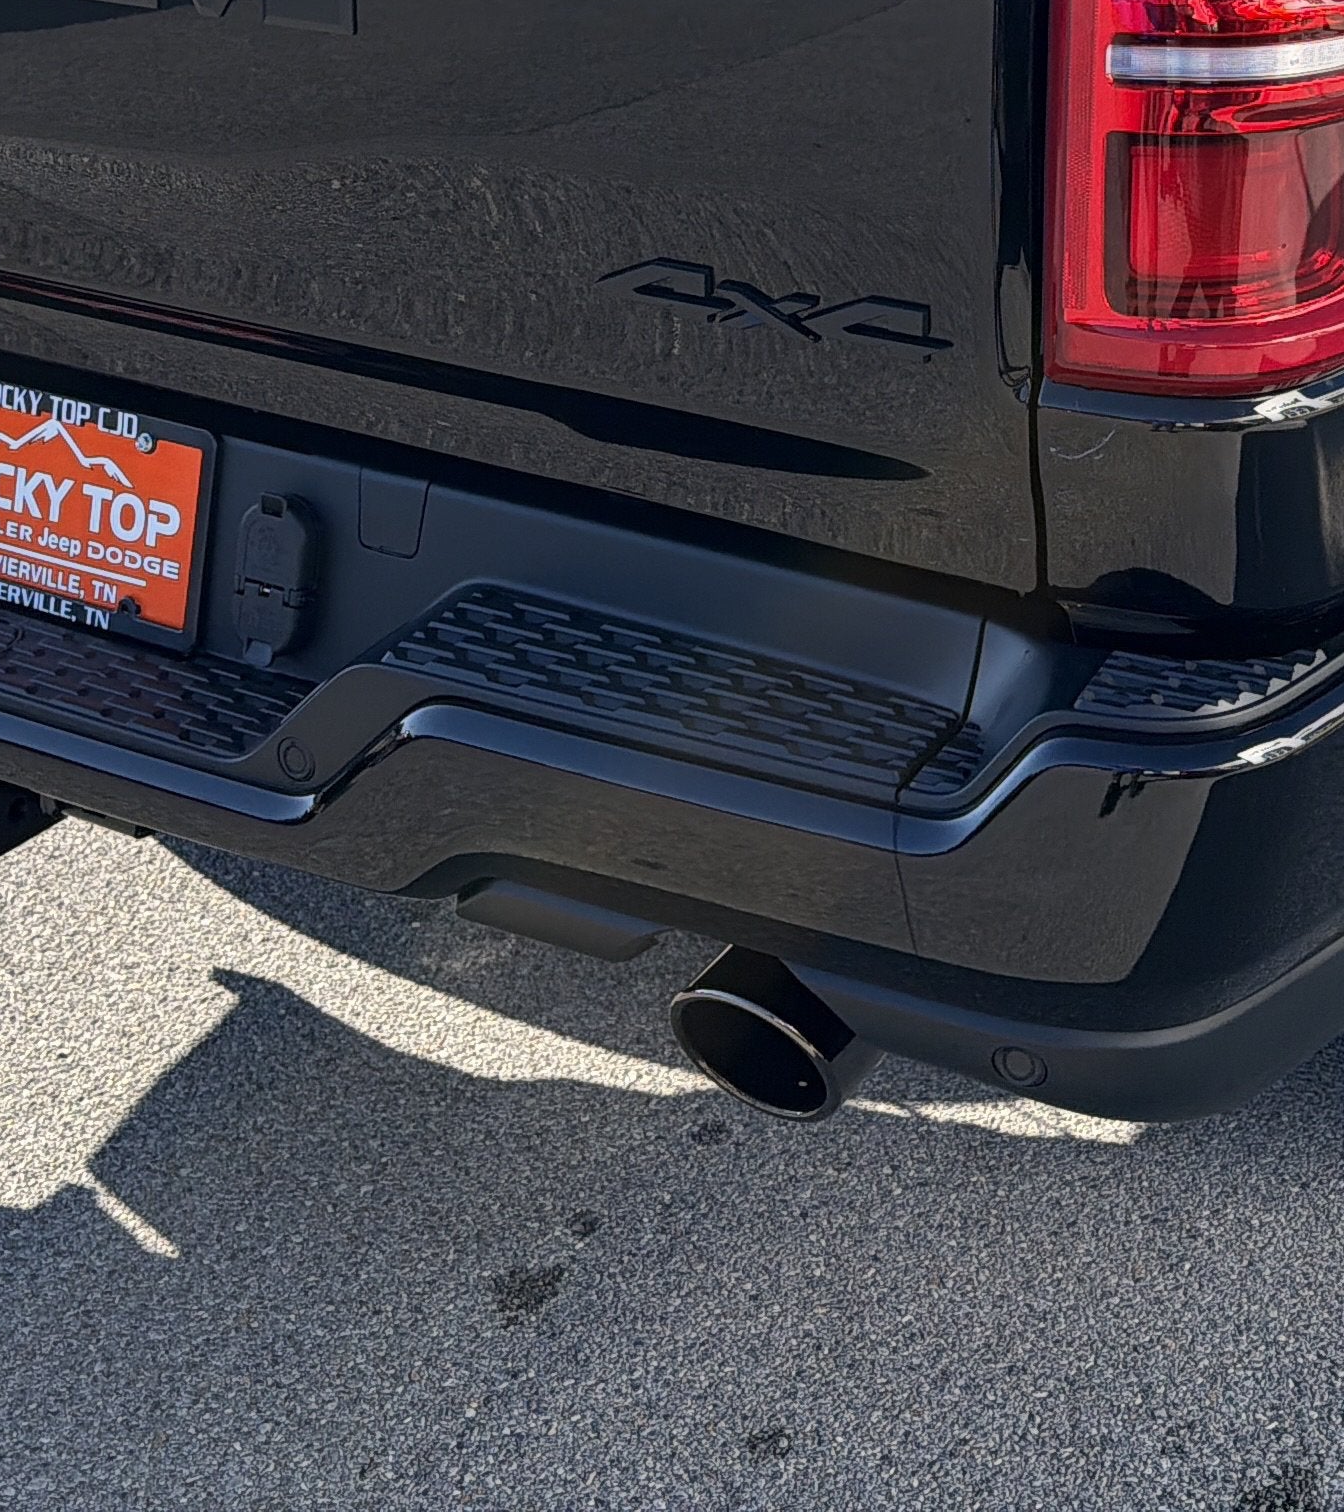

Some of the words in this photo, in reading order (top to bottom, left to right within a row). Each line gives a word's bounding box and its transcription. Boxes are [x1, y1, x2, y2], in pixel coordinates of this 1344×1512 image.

[50, 395, 90, 427] TOP
[98, 407, 138, 439] CJD
[82, 483, 181, 547] TOP
[38, 526, 81, 558] Jeep
[87, 541, 180, 580] DODGE
[92, 580, 117, 604] TN
[84, 606, 110, 630] TN
